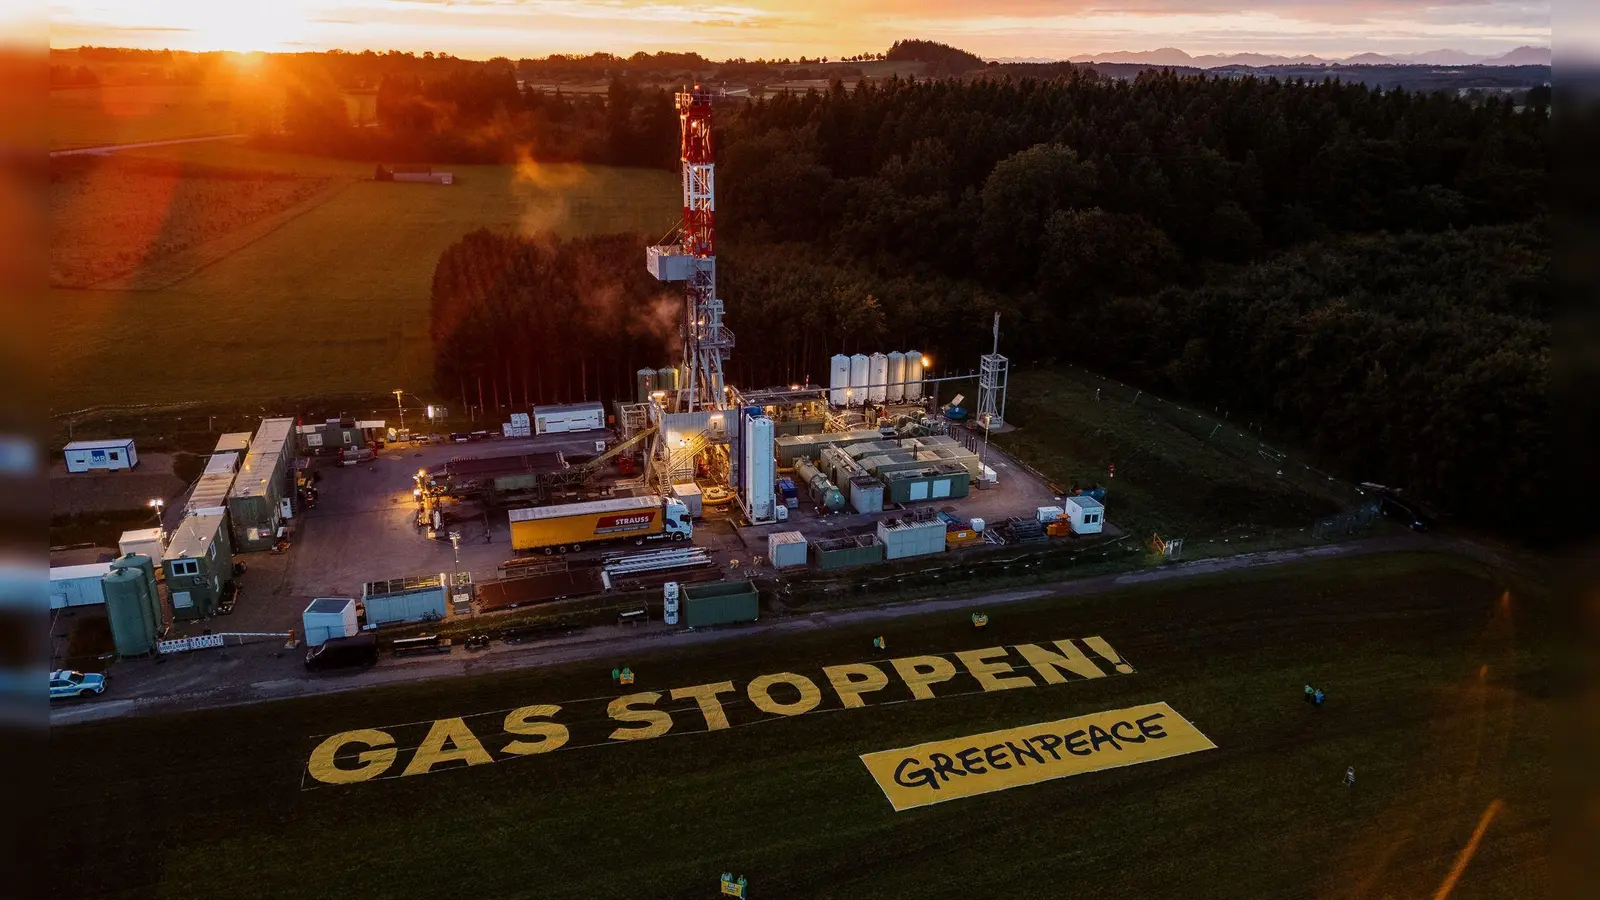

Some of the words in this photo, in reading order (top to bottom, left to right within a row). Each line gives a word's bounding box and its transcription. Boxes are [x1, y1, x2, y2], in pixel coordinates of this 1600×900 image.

[615, 516, 649, 525] STRAUSS
[308, 705, 569, 784] GAS
[607, 636, 1134, 740] STOPPEN!
[894, 714, 1168, 790] GREENPEACE
